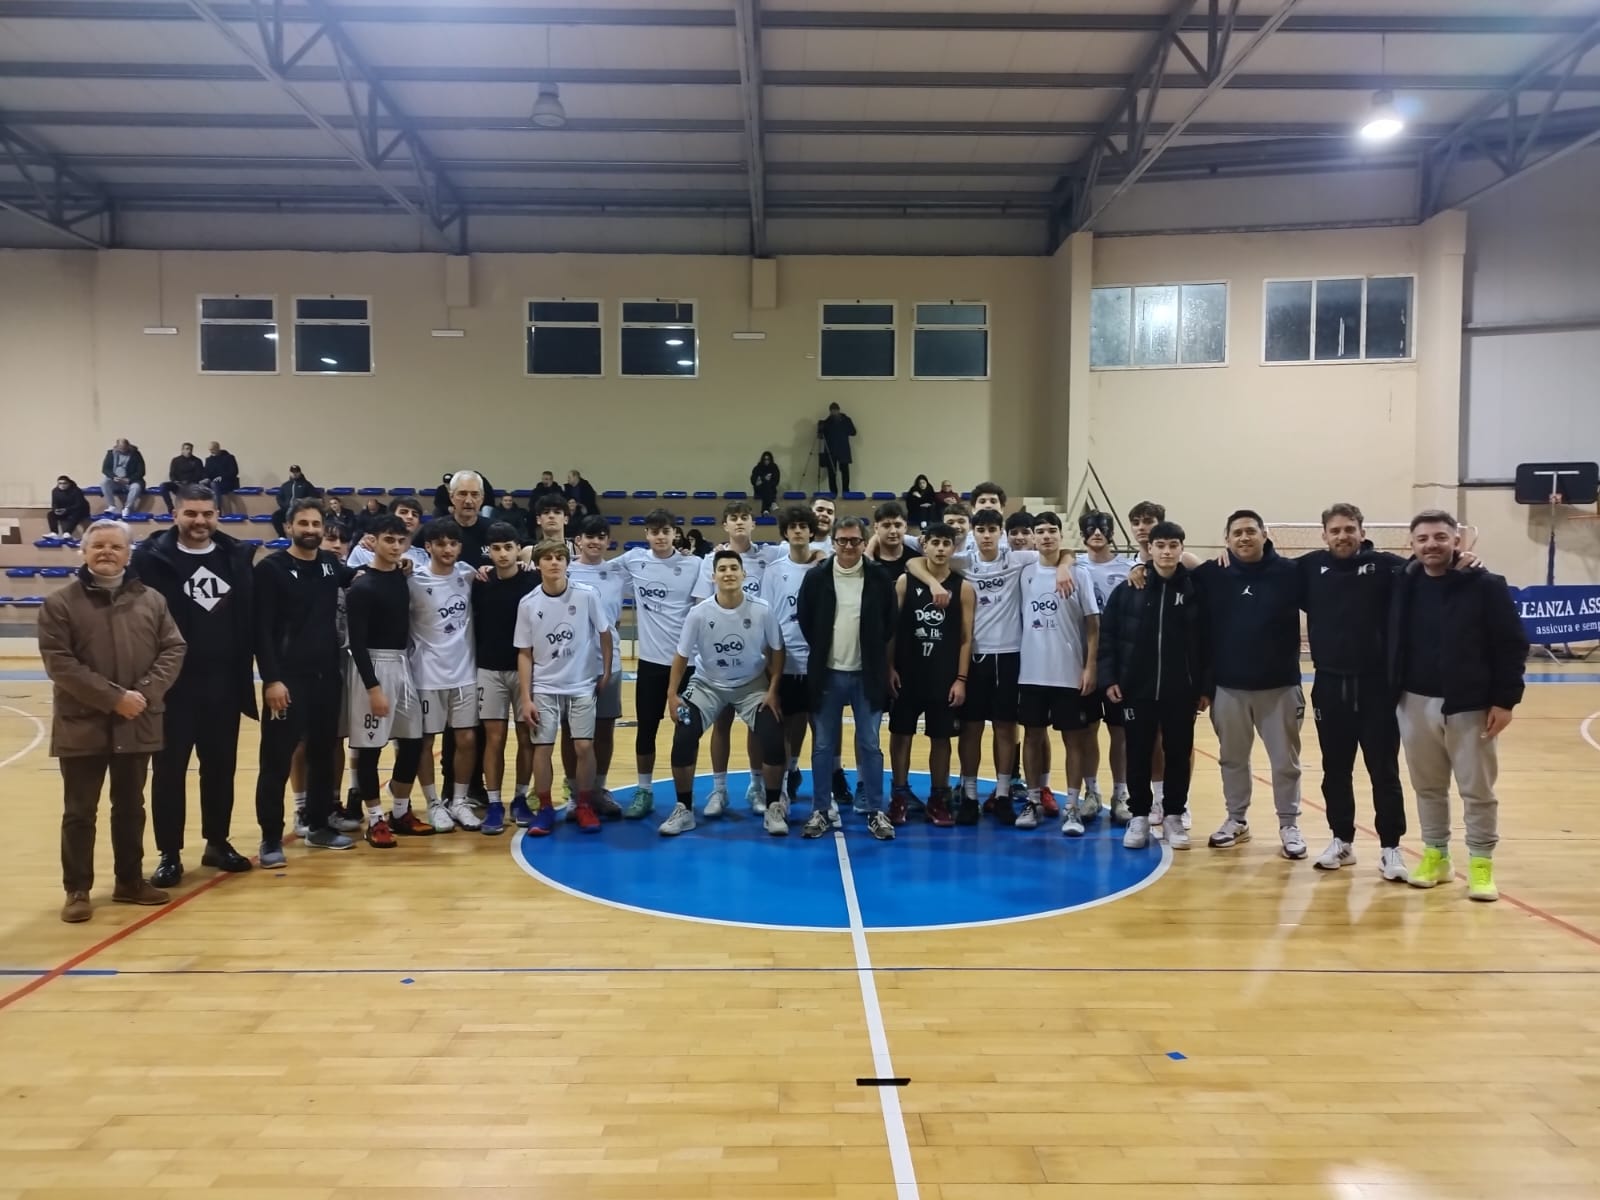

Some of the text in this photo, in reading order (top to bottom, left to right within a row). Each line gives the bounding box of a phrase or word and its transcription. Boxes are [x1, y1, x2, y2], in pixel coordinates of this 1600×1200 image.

[1536, 624, 1573, 635] assicura
[922, 641, 934, 657] 17
[364, 713, 379, 730] 85
